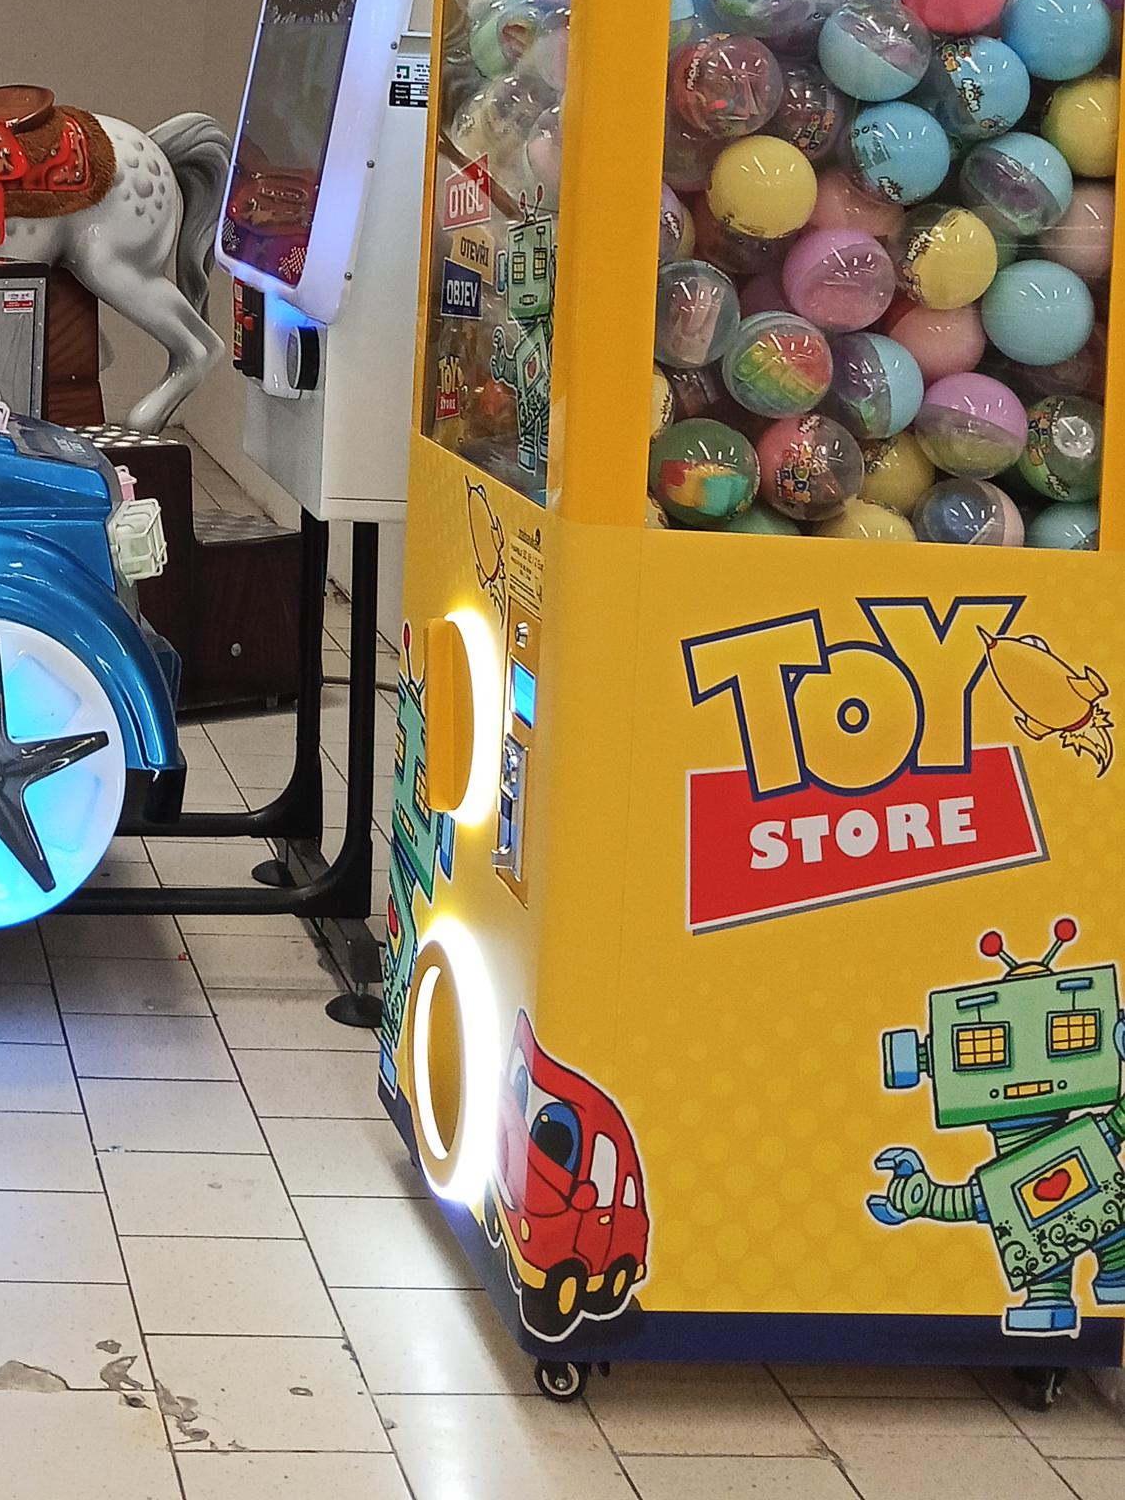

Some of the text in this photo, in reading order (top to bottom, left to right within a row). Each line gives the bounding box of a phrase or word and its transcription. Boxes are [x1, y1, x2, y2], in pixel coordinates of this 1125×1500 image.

[449, 168, 485, 219] OTOČ
[460, 236, 489, 267] OTEVŘI
[446, 279, 478, 308] OBJEV
[438, 354, 460, 395] TOY
[681, 595, 1027, 802] TOY
[749, 795, 977, 870] STORE
